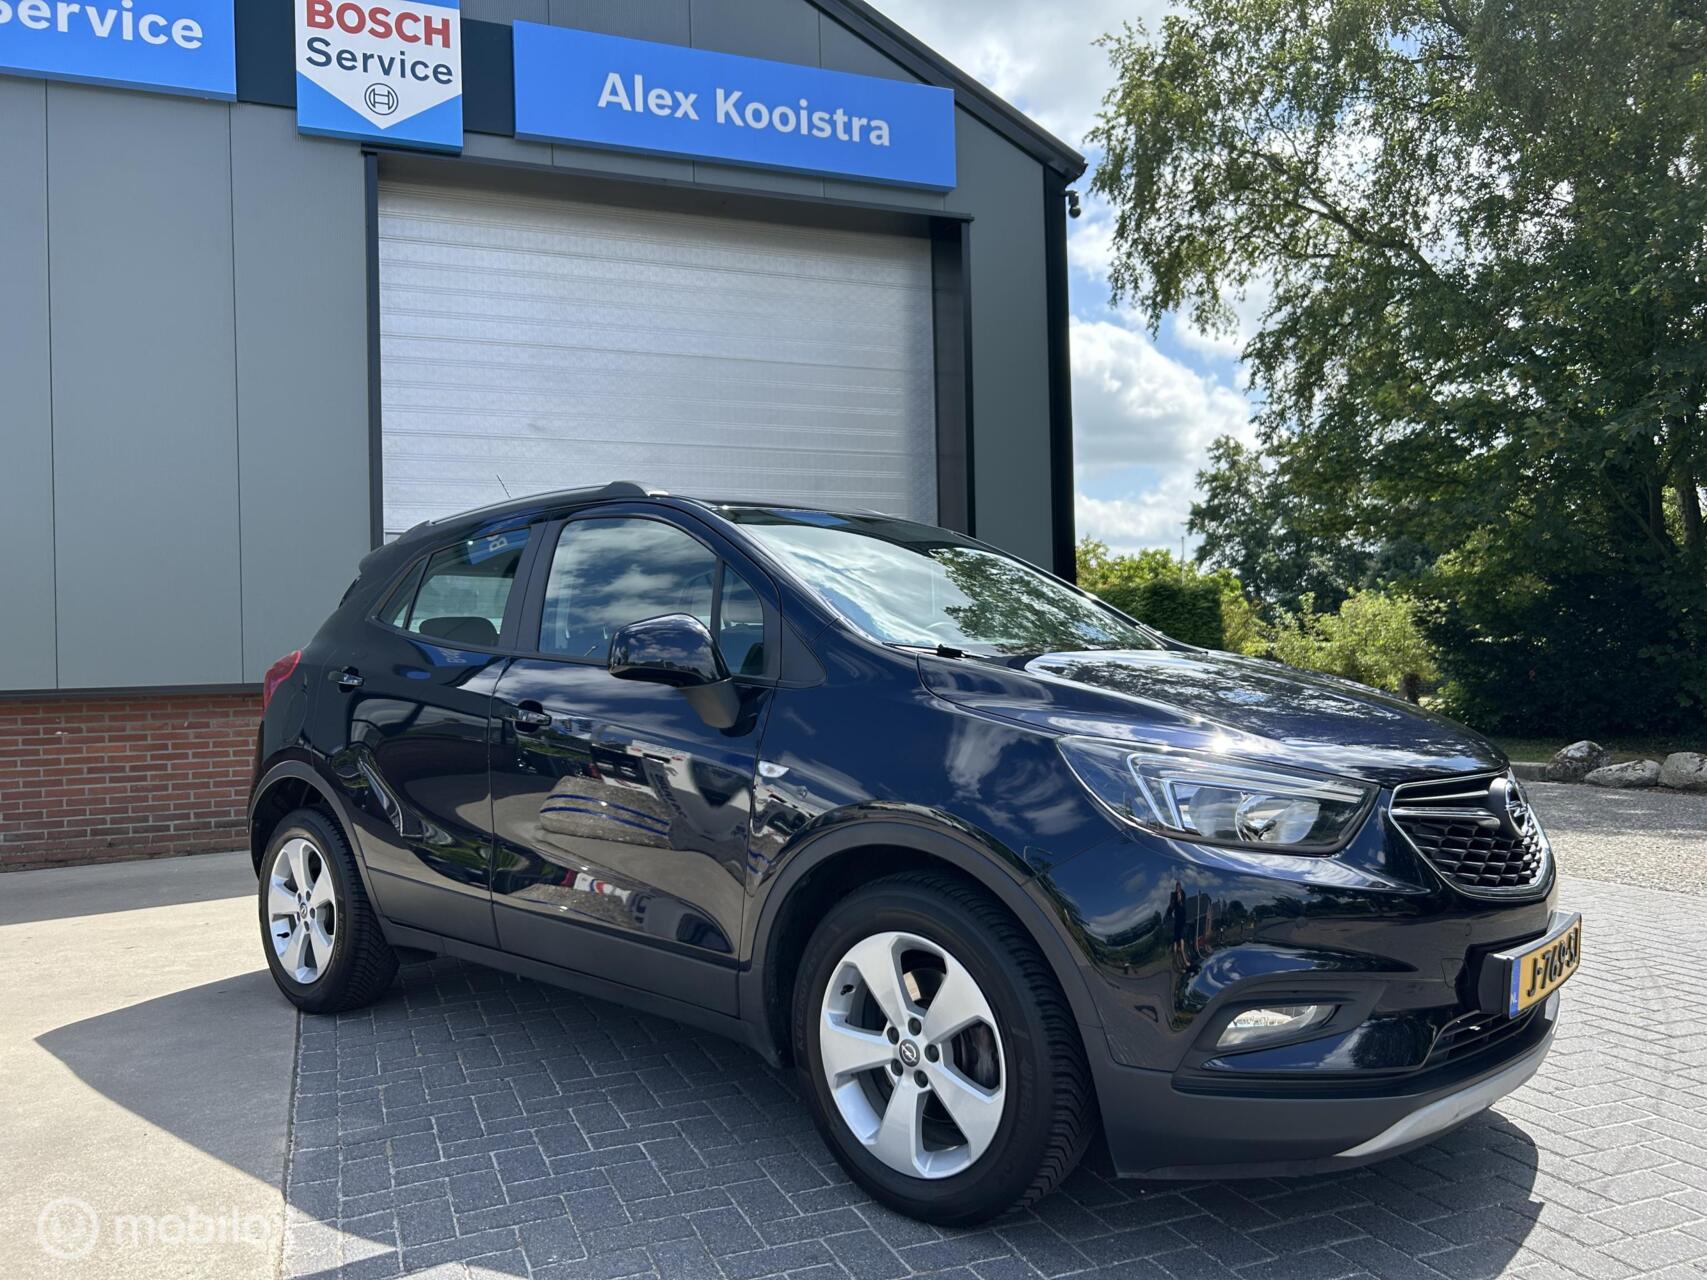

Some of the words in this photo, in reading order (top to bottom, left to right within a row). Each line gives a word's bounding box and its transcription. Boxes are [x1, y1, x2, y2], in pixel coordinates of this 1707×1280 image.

[306, 0, 451, 49] BOSCH
[305, 36, 454, 85] Service
[597, 72, 700, 121] Alex
[715, 87, 891, 147] Kooistra
